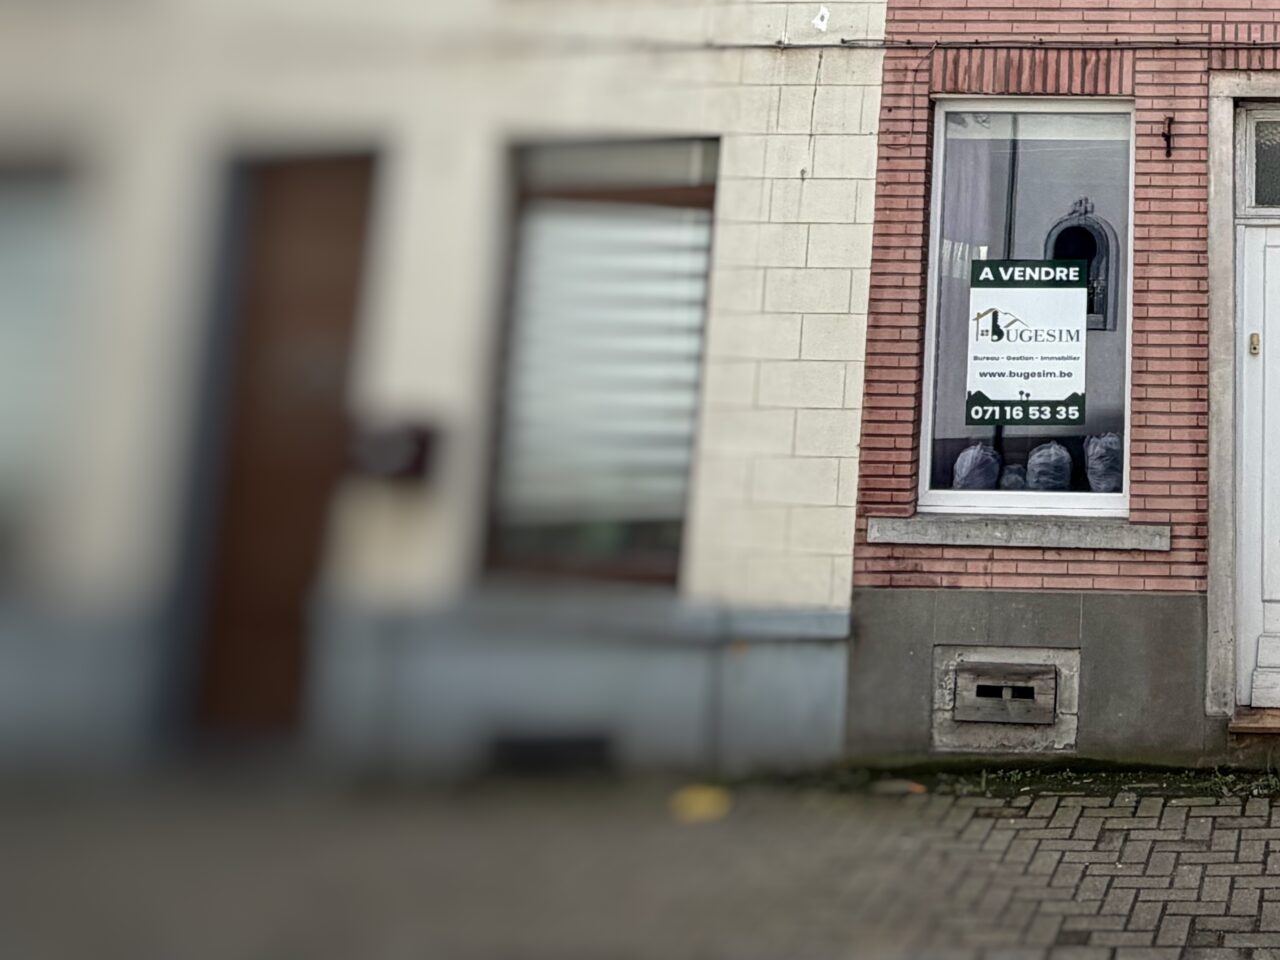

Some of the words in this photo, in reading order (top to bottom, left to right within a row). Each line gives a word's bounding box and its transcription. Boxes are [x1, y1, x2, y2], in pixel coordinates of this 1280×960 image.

[979, 267, 994, 281] A
[998, 267, 1080, 281] VENDRE
[979, 370, 1073, 380] www.bugesim.be
[971, 406, 1000, 420] 071
[1004, 406, 1024, 420] 16
[1028, 406, 1051, 420] 53
[1056, 406, 1080, 420] 35
